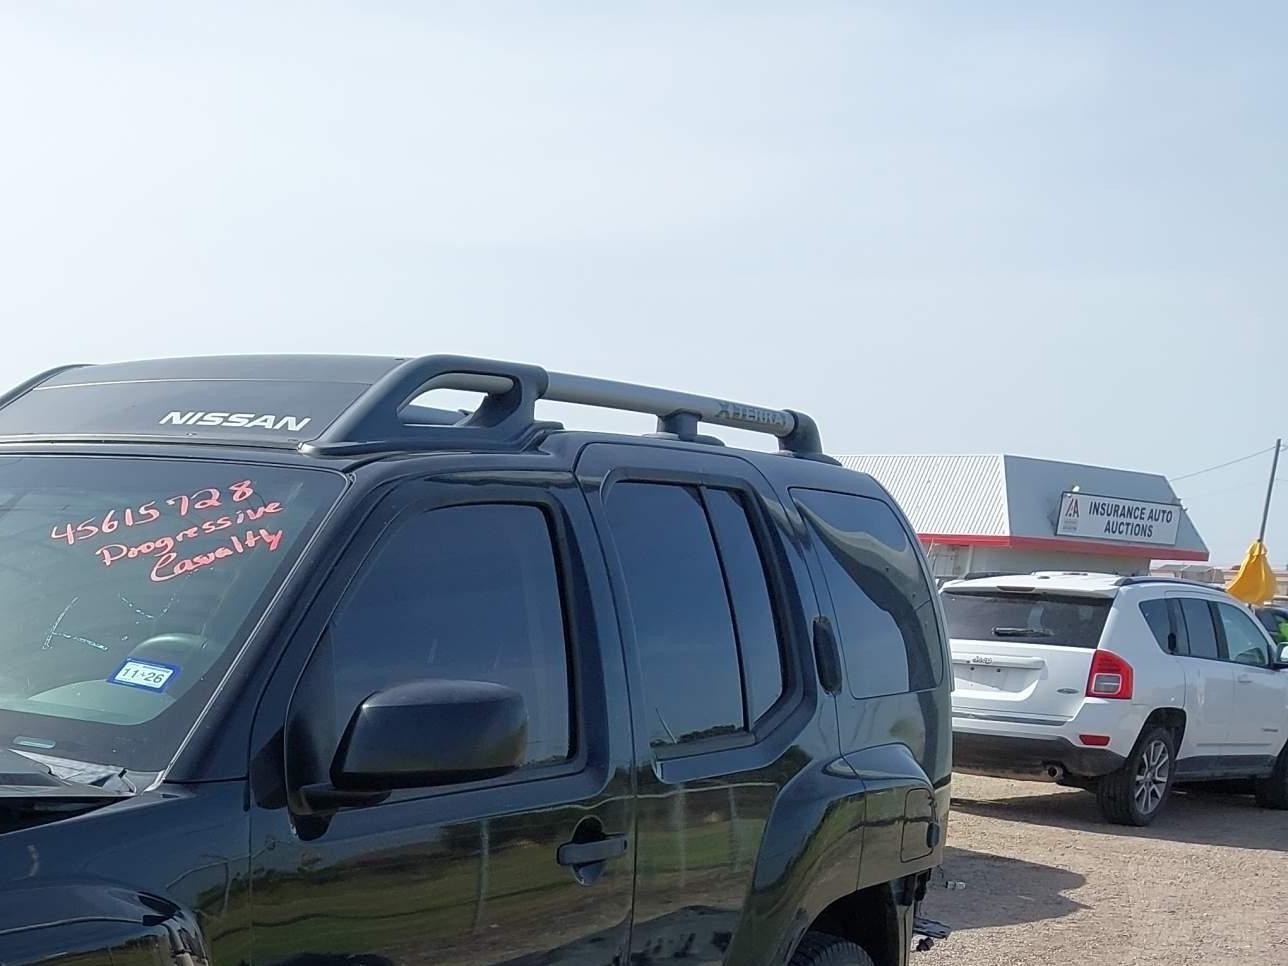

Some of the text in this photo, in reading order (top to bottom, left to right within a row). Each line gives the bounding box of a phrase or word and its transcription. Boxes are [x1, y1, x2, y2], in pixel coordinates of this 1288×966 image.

[159, 410, 312, 432] NISSAN
[1088, 501, 1174, 524] INSURANCE AUTO
[1103, 519, 1154, 538] AUCTIONS
[150, 528, 283, 582] Casualty
